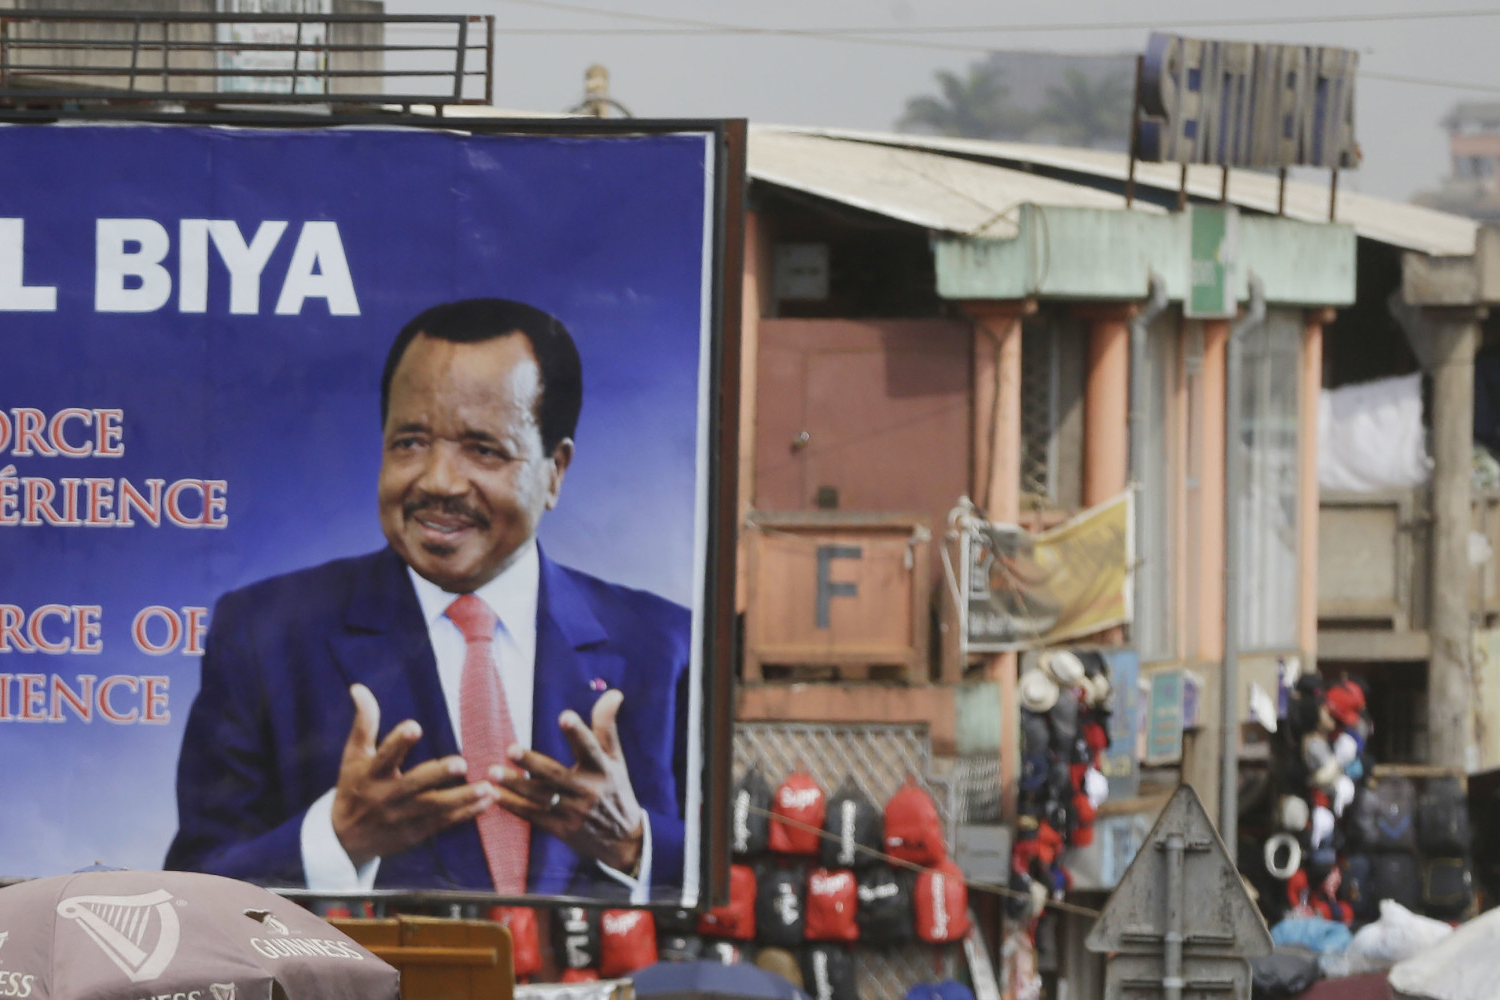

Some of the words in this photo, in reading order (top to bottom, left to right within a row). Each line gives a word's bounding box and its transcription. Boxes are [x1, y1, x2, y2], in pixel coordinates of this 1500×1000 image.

[94, 218, 361, 316] BIYA
[816, 545, 864, 629] F
[132, 606, 208, 655] OF
[250, 936, 365, 962] GUINNESS
